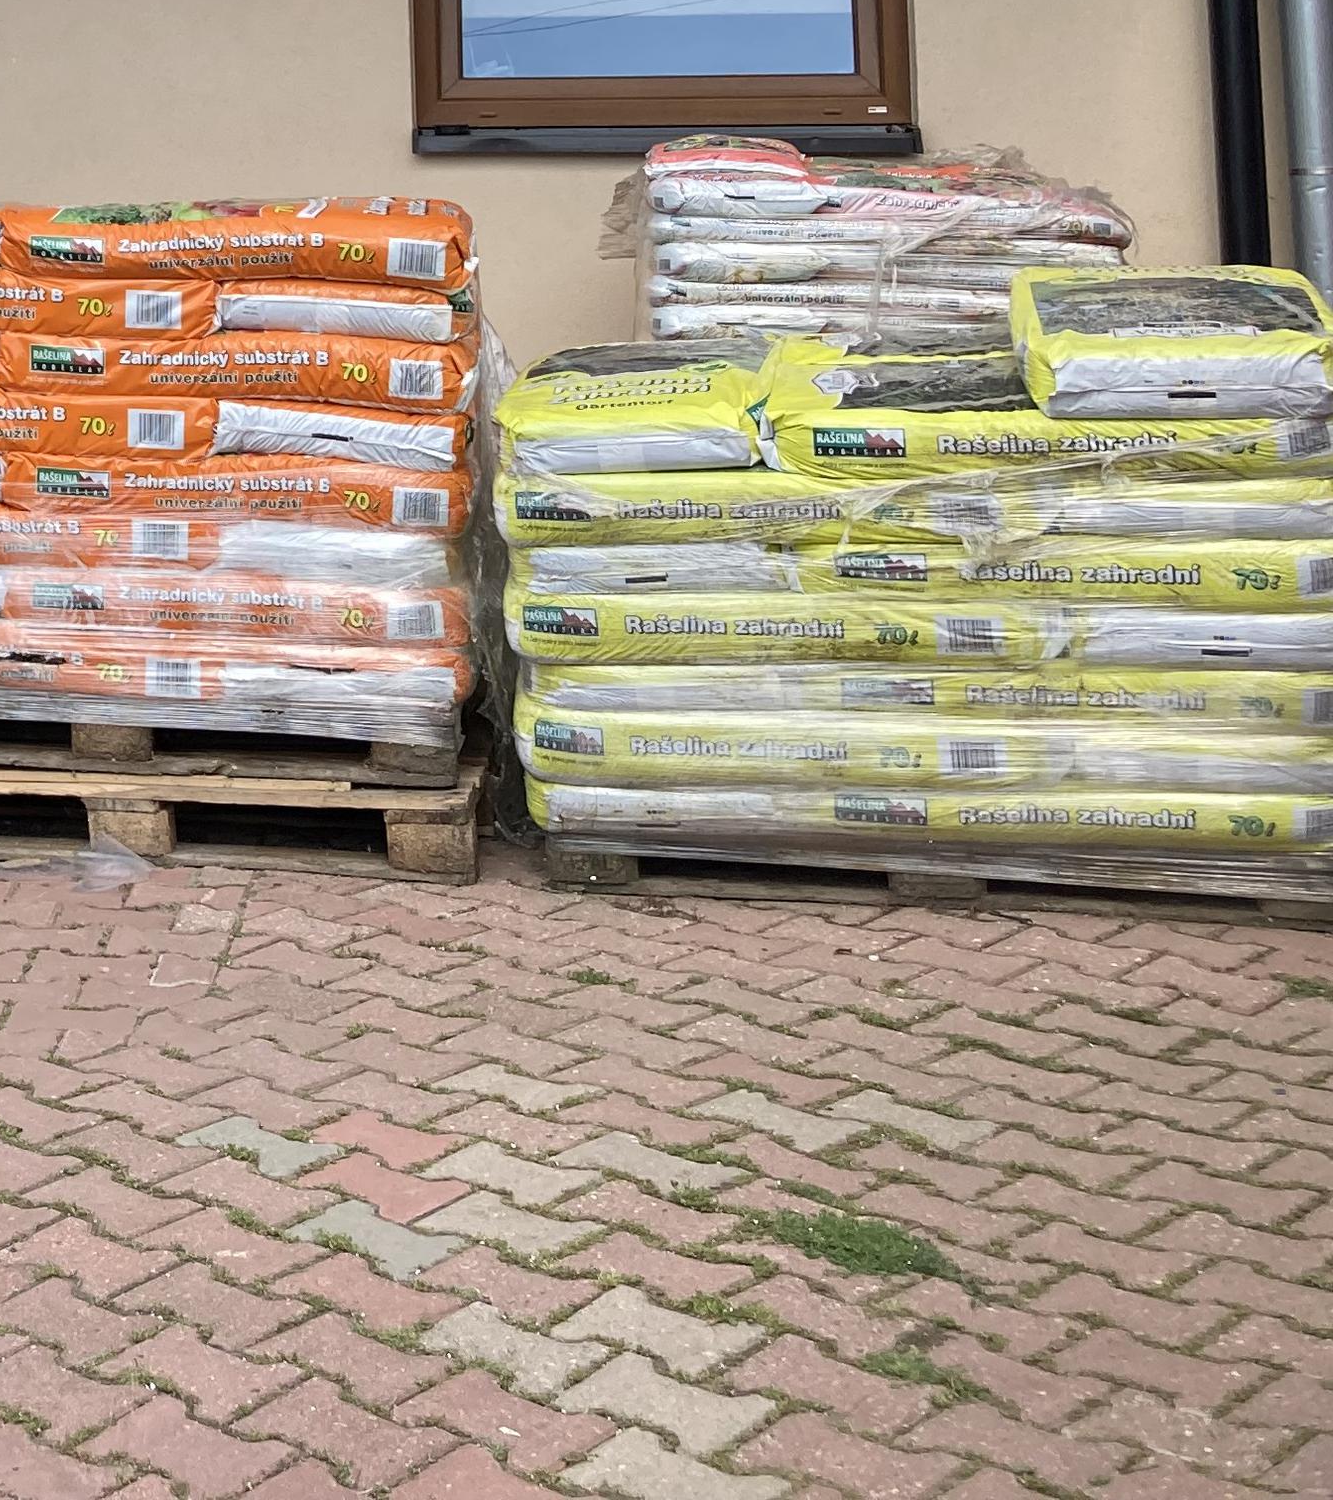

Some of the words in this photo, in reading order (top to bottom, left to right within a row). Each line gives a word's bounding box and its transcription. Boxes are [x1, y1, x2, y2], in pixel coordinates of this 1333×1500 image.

[118, 235, 224, 253] Zahradnický
[310, 232, 324, 247] B
[50, 288, 64, 302] B
[32, 349, 72, 362] RAŠELINA
[119, 349, 229, 367] Zahradnický
[234, 350, 310, 366] substrát
[316, 351, 329, 366] B
[149, 370, 238, 384] univerzální
[52, 407, 66, 421] B
[816, 432, 865, 445] RAŠELINA
[937, 432, 1050, 454] Rašelina
[1059, 430, 1178, 453] zahradní
[39, 471, 78, 485] RAŠELINA
[124, 473, 234, 493] Zahradnický
[240, 477, 313, 493] substrát
[318, 477, 331, 493] B
[618, 497, 722, 520] Rašelina
[67, 519, 81, 534] B
[1081, 563, 1200, 585] zahradní
[624, 615, 727, 635] Rašelina
[734, 619, 845, 639] zahradní
[965, 684, 1079, 707] Rašelina
[1086, 688, 1206, 711] zahradní
[630, 735, 731, 757] Rašelina
[739, 739, 848, 761] zahradní
[958, 803, 1069, 826] Rašelina
[1078, 808, 1197, 830] zahradní
